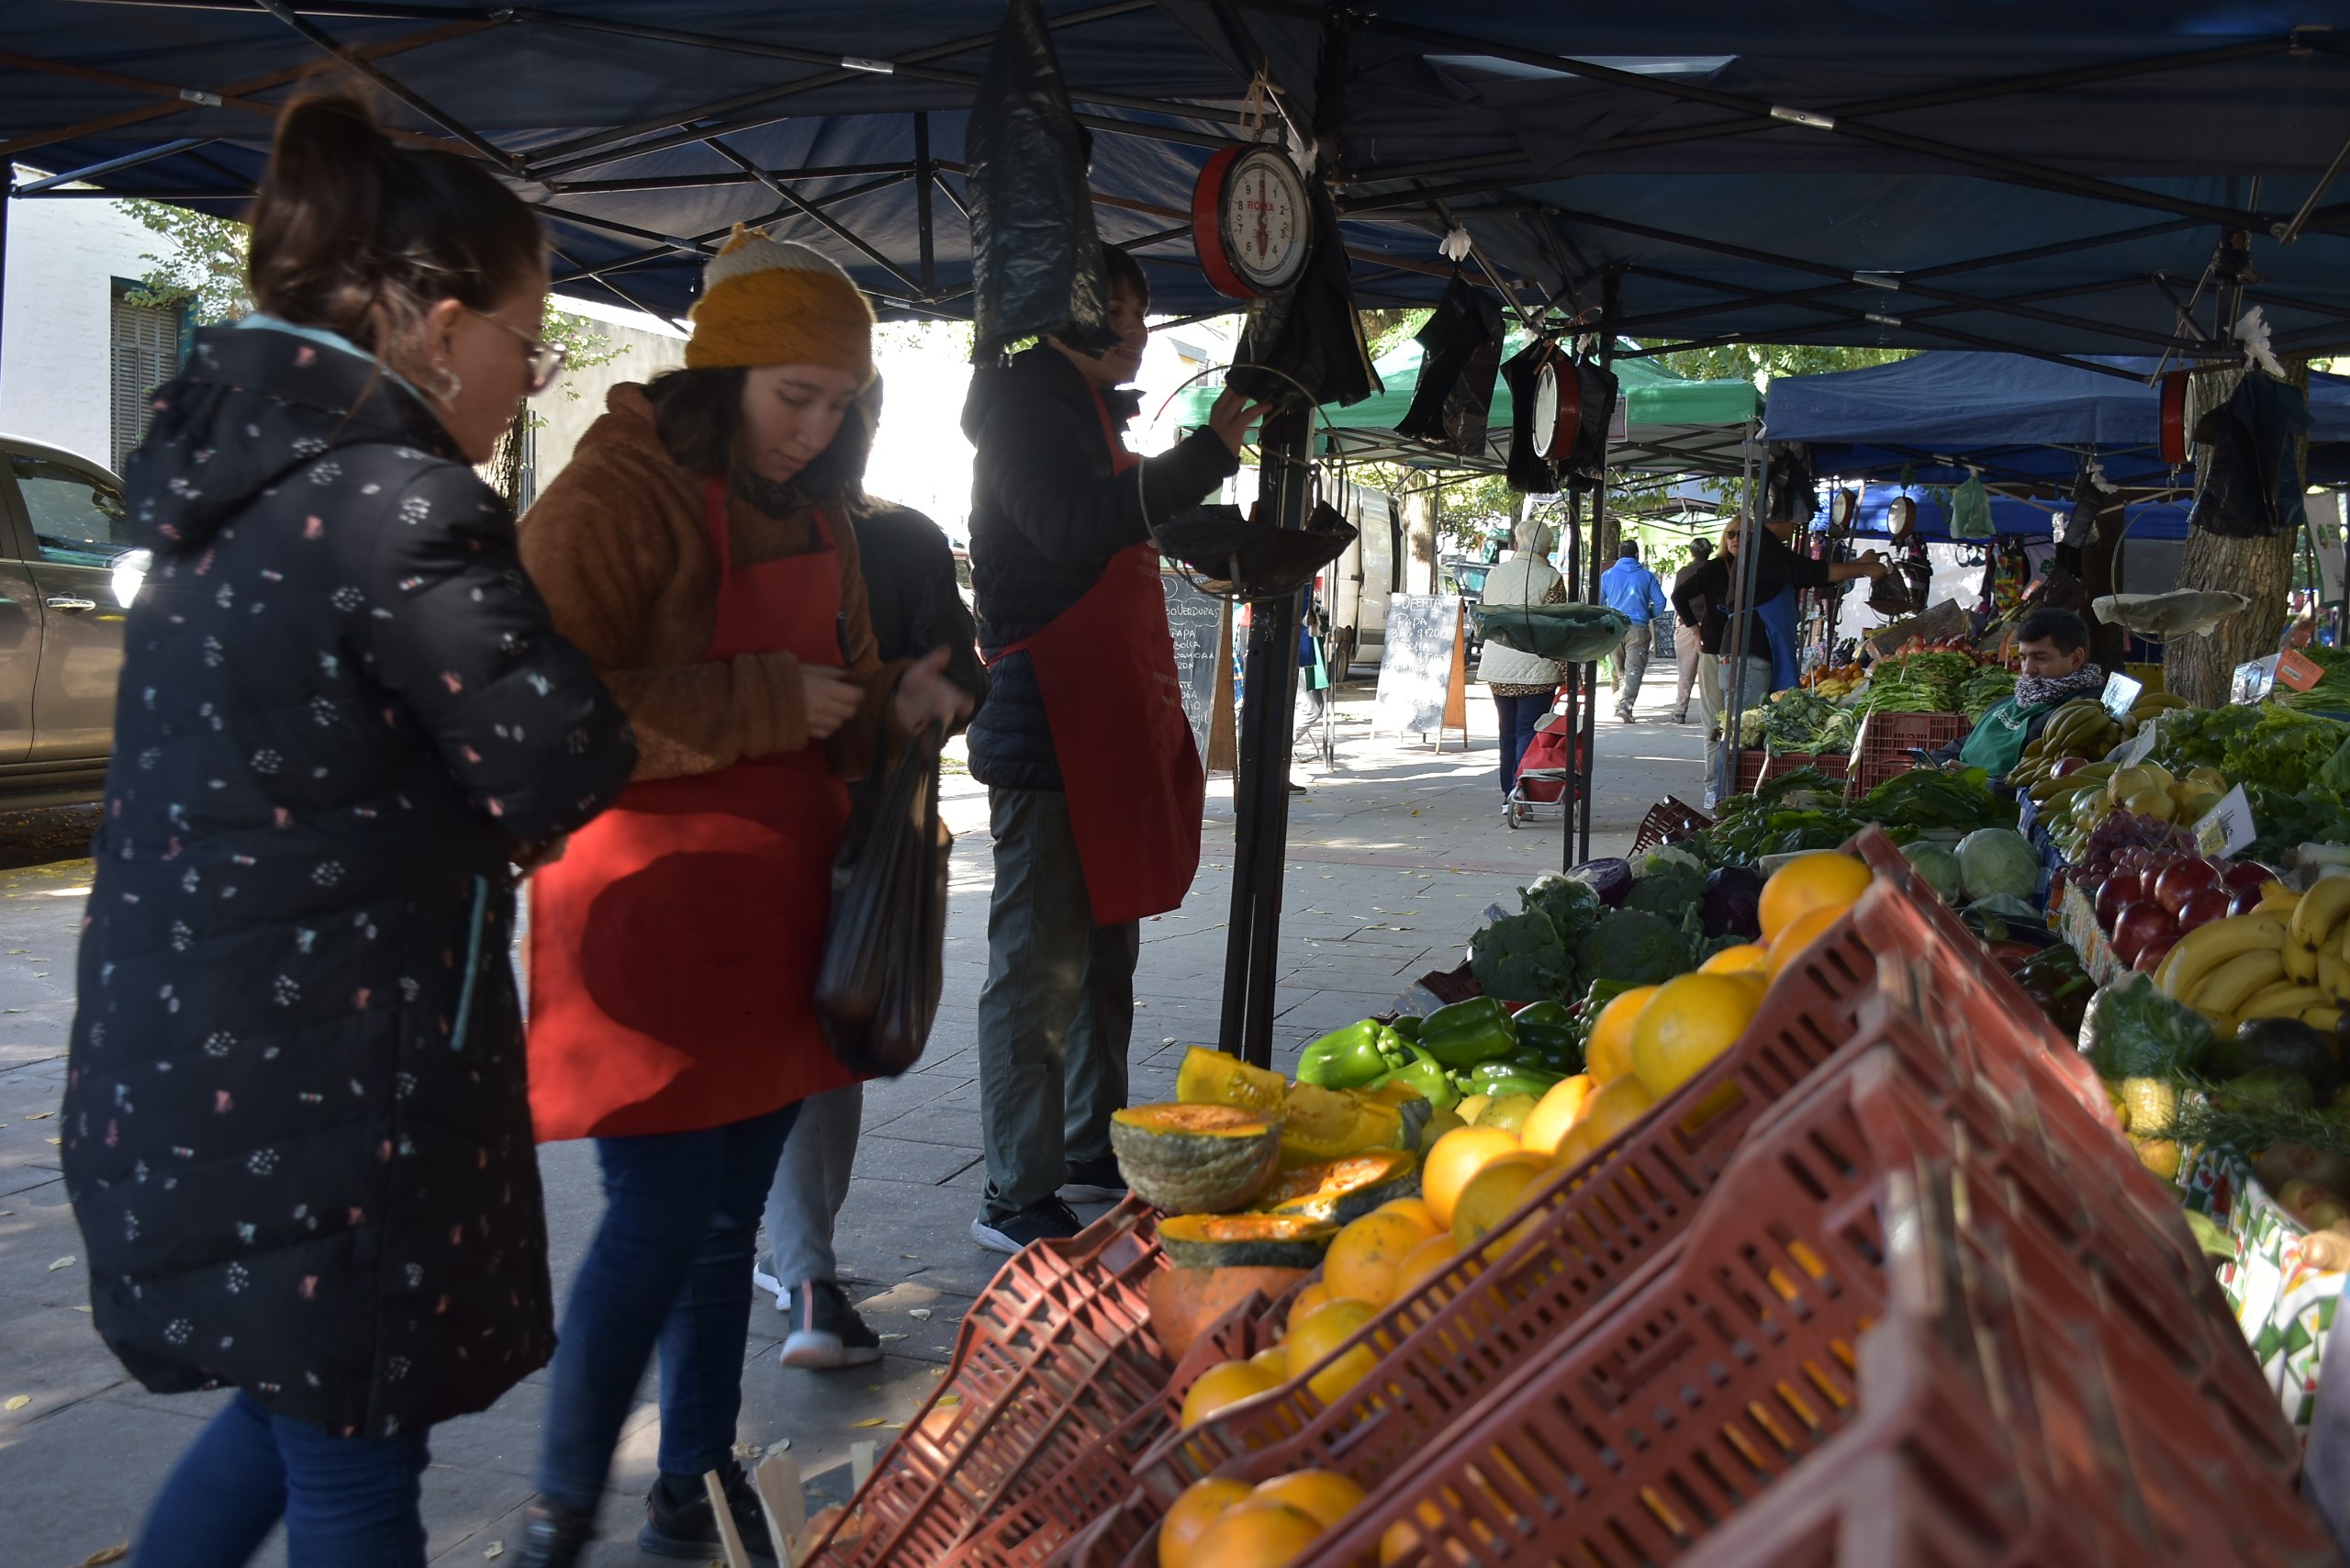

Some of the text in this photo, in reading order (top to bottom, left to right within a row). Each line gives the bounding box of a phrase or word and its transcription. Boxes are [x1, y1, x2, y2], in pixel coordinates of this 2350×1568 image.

[1246, 185, 1251, 195] 9
[1272, 188, 1277, 198] 1
[1237, 200, 1243, 210] 8
[1280, 205, 1285, 216] 2
[1238, 223, 1243, 233] 7
[1280, 229, 1285, 239] 3
[1247, 241, 1251, 252] 6
[1272, 245, 1277, 254] 4
[1402, 596, 1443, 610] OFERTA
[1393, 612, 1427, 630] PAPA
[1169, 628, 1196, 641] PAPA
